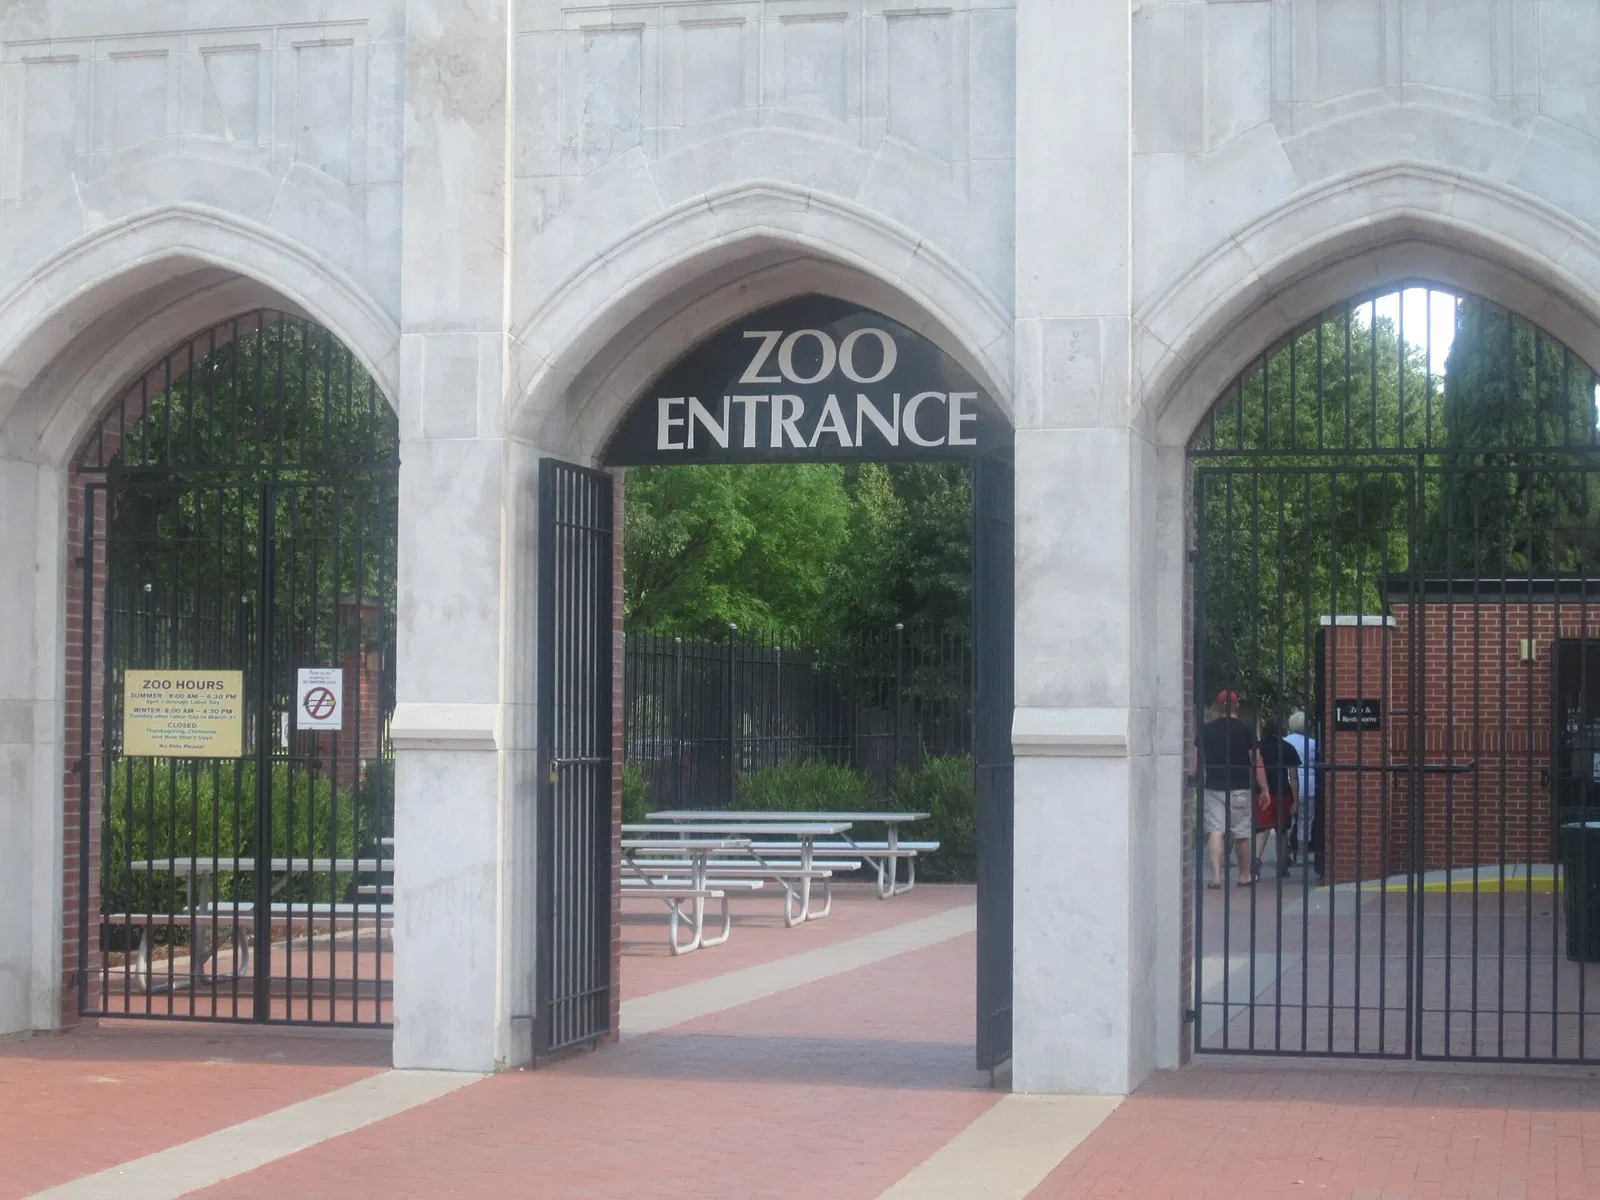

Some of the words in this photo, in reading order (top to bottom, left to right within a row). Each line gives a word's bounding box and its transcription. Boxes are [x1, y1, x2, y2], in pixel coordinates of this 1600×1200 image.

[738, 327, 898, 385] ZOO
[657, 391, 978, 450] ENTRANCE
[142, 680, 171, 690] ZOO
[176, 680, 224, 690] HOURS
